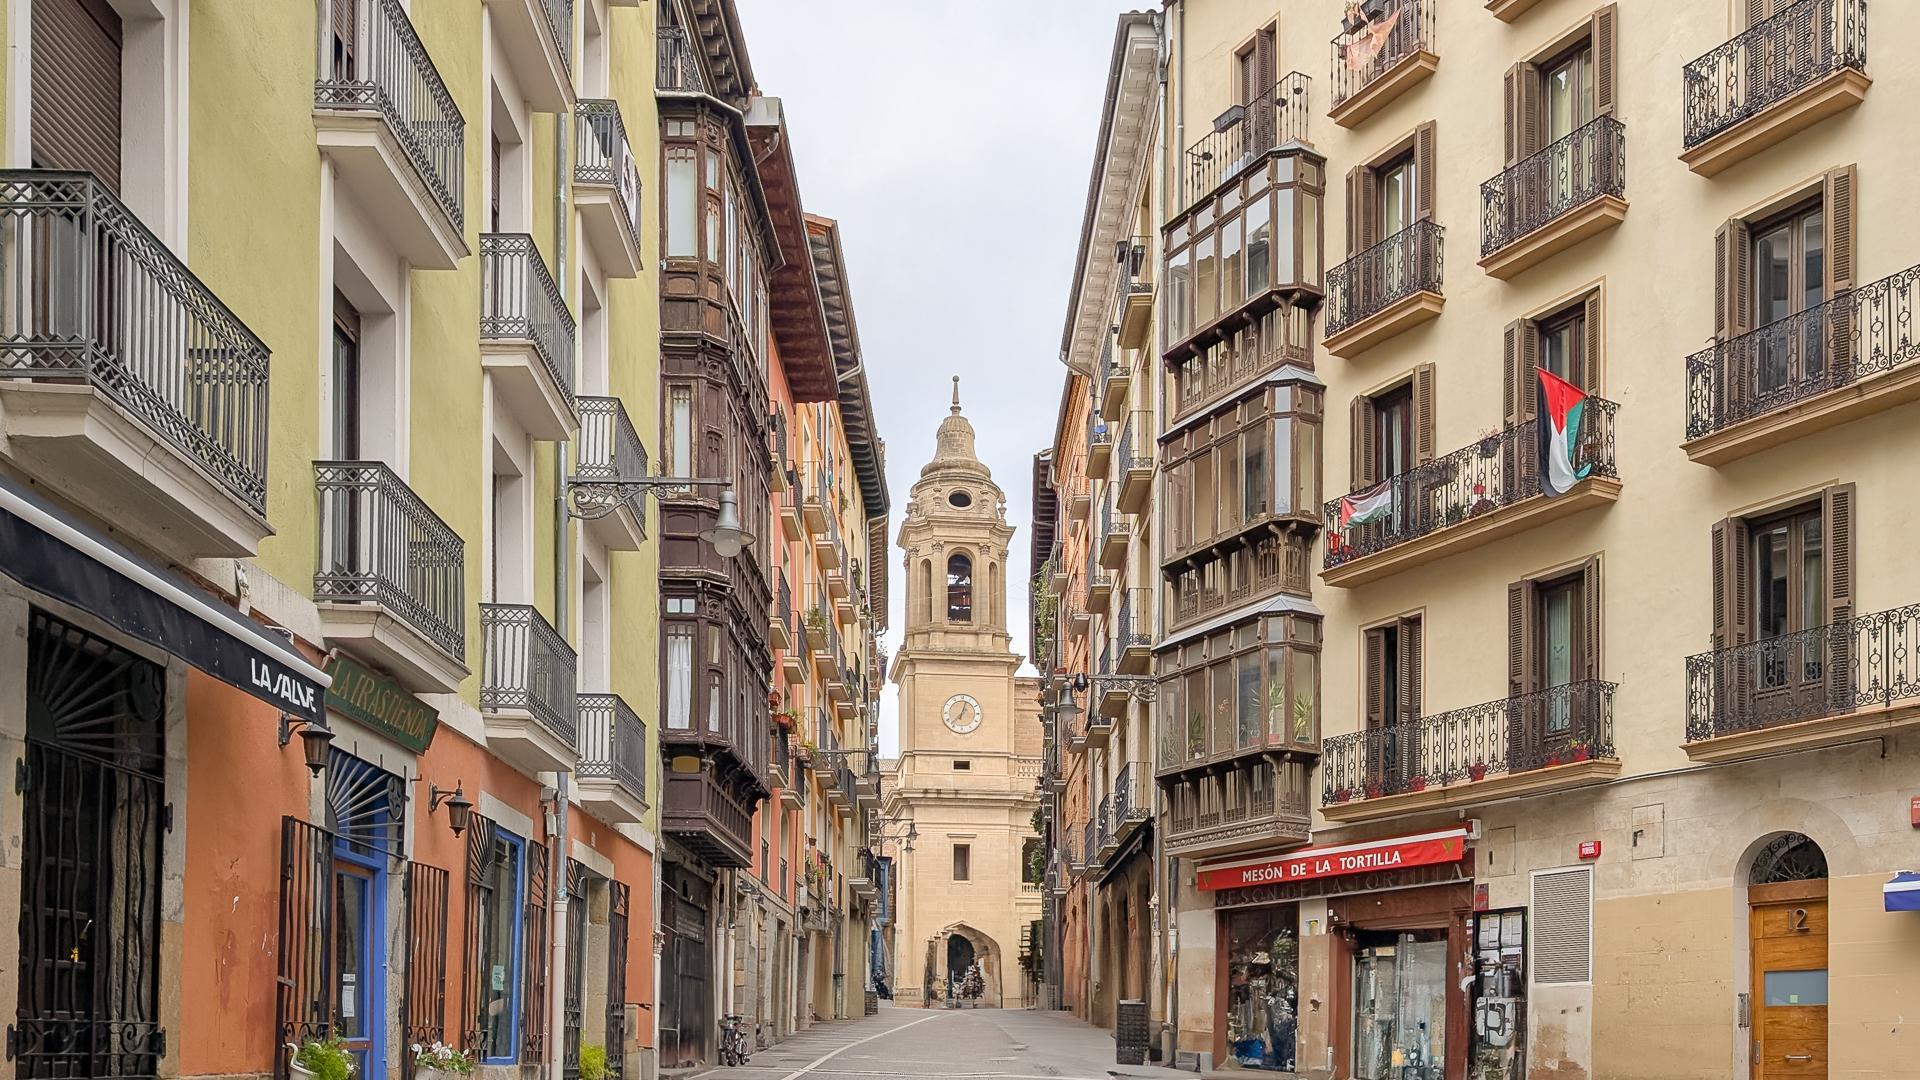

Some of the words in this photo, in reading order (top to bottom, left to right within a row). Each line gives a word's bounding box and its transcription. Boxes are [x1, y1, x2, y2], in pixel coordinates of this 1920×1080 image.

[251, 658, 272, 693] LA
[272, 673, 317, 713] SALVE
[331, 659, 350, 700] LA
[1242, 864, 1282, 882] MESÓN
[1291, 863, 1307, 876] DE
[1315, 859, 1331, 874] LA
[1339, 850, 1402, 870] TORTILLA
[1786, 908, 1809, 931] 12
